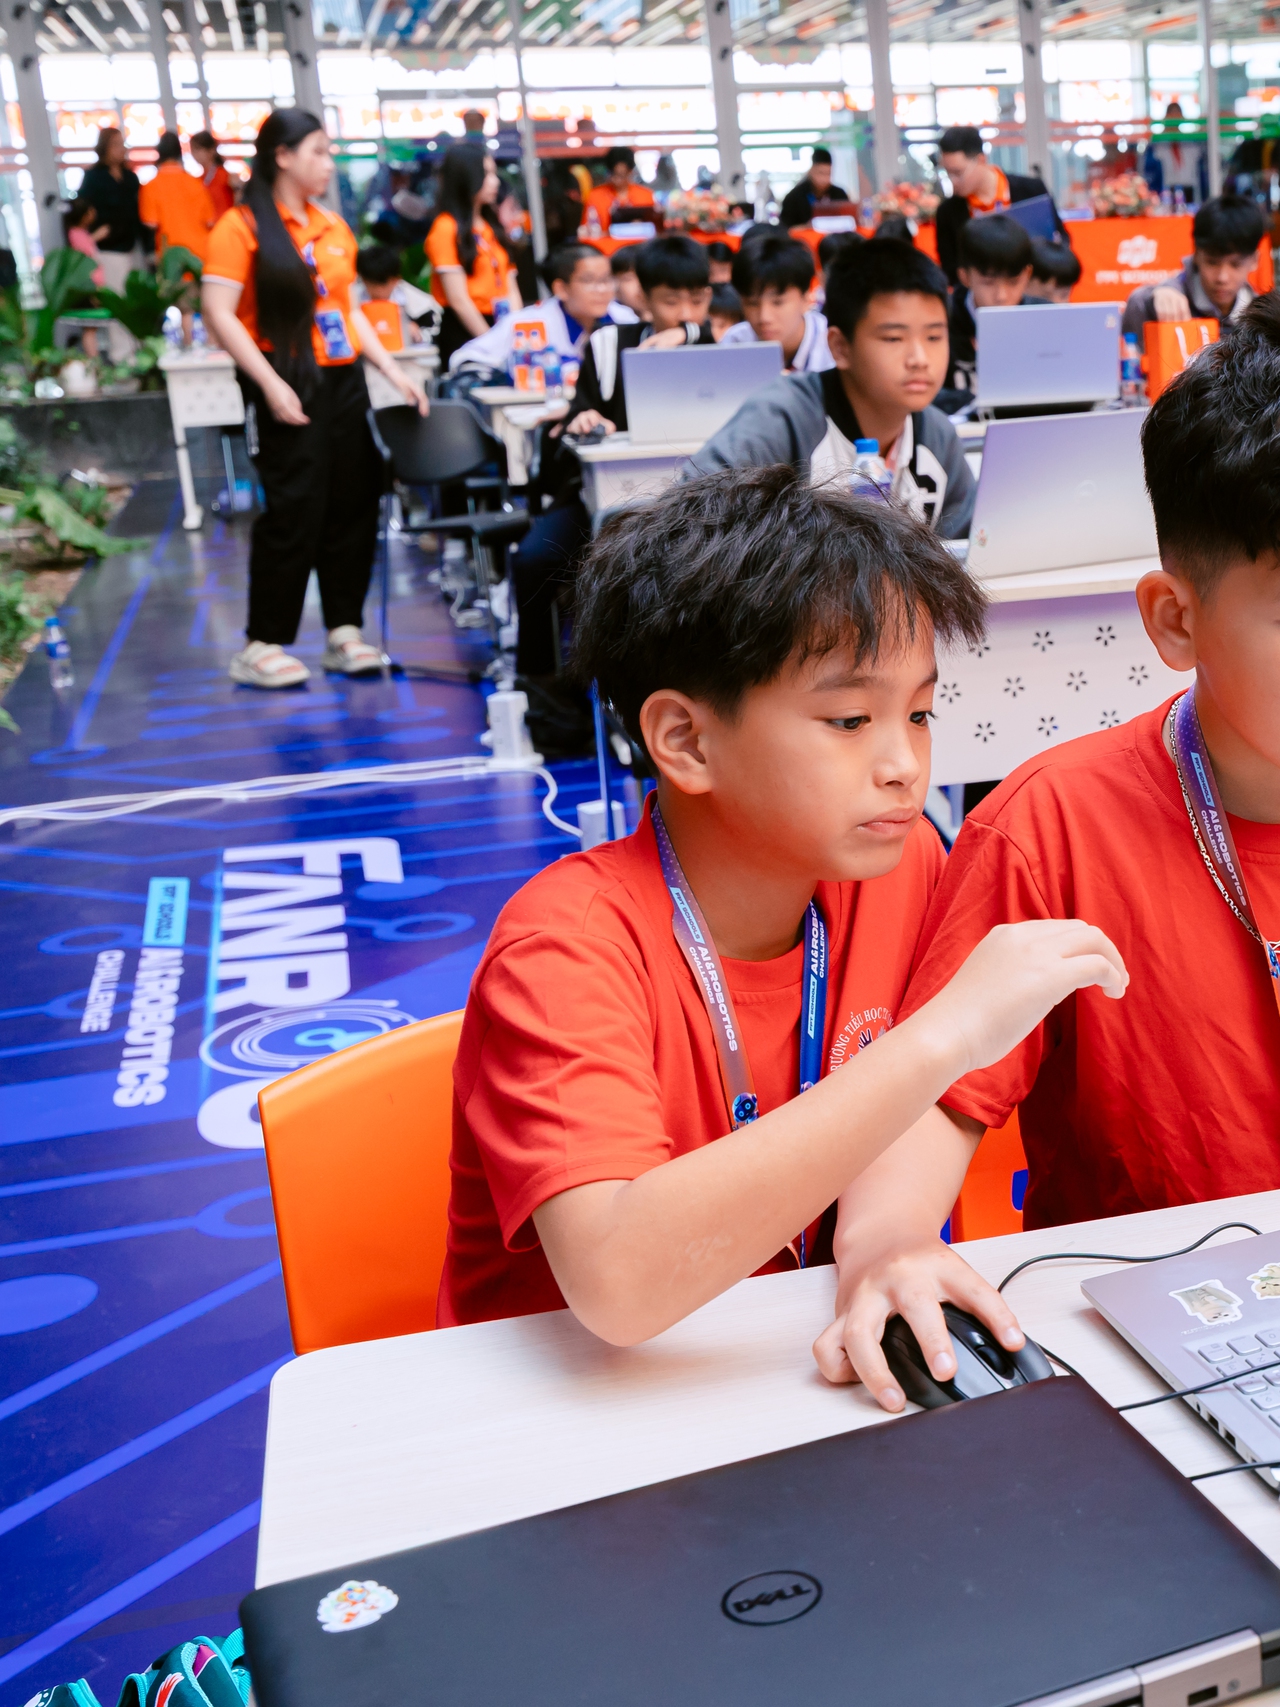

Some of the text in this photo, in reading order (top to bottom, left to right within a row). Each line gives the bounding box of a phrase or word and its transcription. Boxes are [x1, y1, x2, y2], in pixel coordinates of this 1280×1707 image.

[1201, 810, 1223, 865] CHALLENGE
[682, 905, 700, 941] SCHOOLS
[689, 946, 715, 1005] CHALLENGE
[830, 1033, 850, 1071] RƯỜNG
[865, 1007, 882, 1023] HỌC
[733, 1584, 812, 1613] DELL
